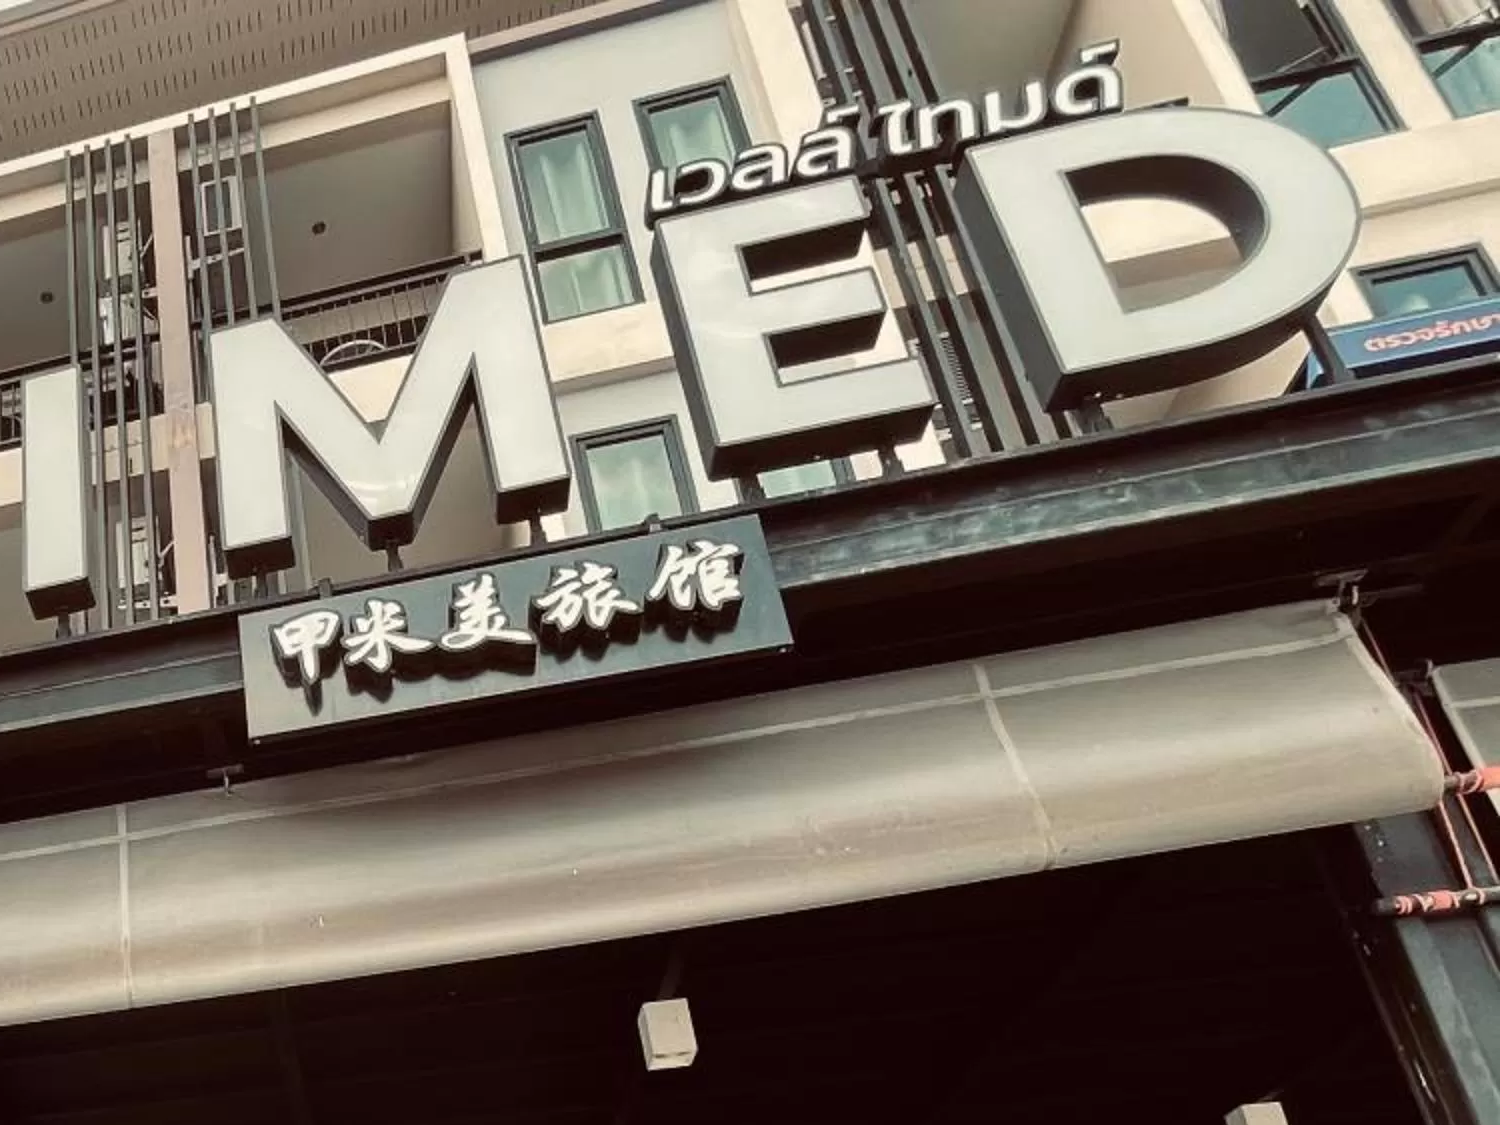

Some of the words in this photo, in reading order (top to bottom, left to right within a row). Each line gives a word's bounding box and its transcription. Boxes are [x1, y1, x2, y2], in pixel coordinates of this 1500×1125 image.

[649, 106, 860, 212] เวลล์
[882, 42, 1125, 156] ไทมด์
[273, 539, 746, 684] 甲米美旅馆
